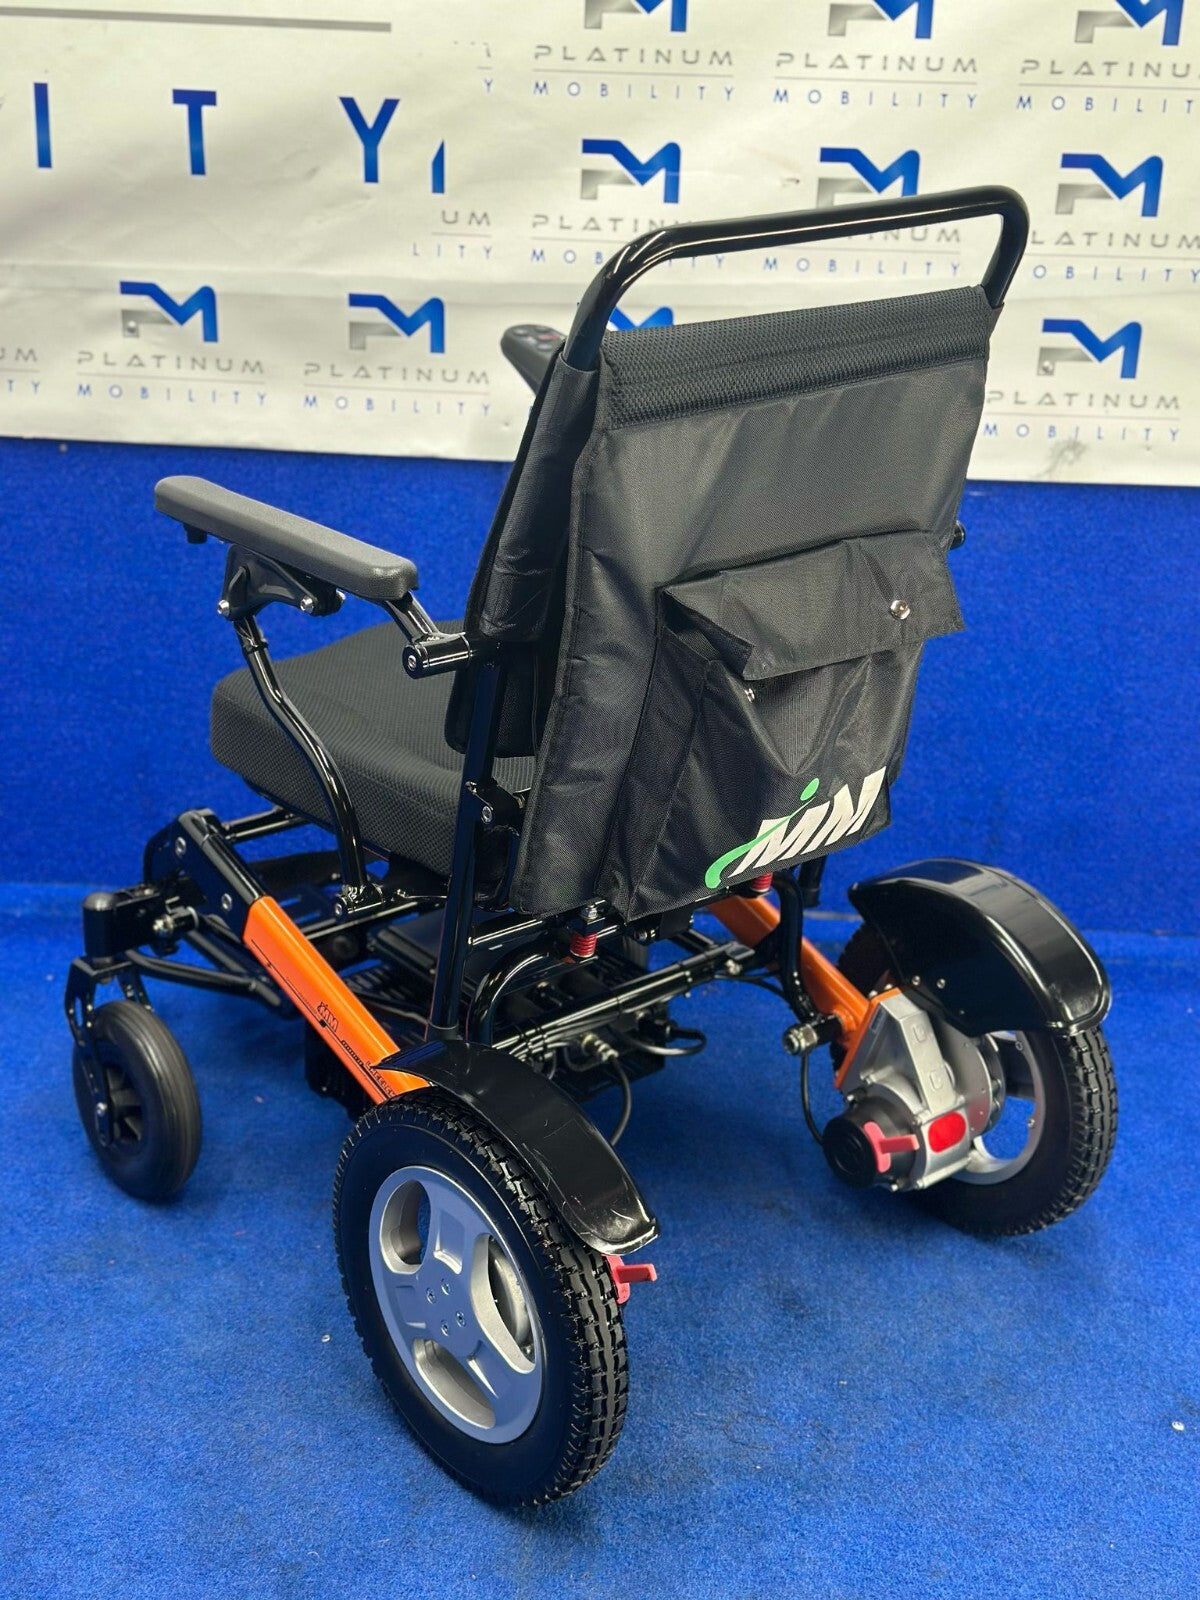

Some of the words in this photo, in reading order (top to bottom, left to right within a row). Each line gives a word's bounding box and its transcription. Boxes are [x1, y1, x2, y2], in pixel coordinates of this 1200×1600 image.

[534, 45, 734, 66] PLATINUM
[776, 52, 979, 73] PLATINUM
[1020, 59, 1200, 79] PLATINU
[533, 80, 735, 101] MOBILITY
[773, 89, 978, 109] MOBILITY
[1030, 230, 1200, 250] LATINUM
[763, 257, 961, 275] MOBILITY
[1033, 264, 1200, 283] OBILITY
[77, 350, 265, 374] PLATINUM
[303, 362, 490, 385] PLATINUM
[77, 383, 268, 407] MOBILITY
[303, 394, 492, 416] MOBILITY
[985, 390, 1181, 410] PLATINUM
[983, 422, 1181, 442] MOBILITY
